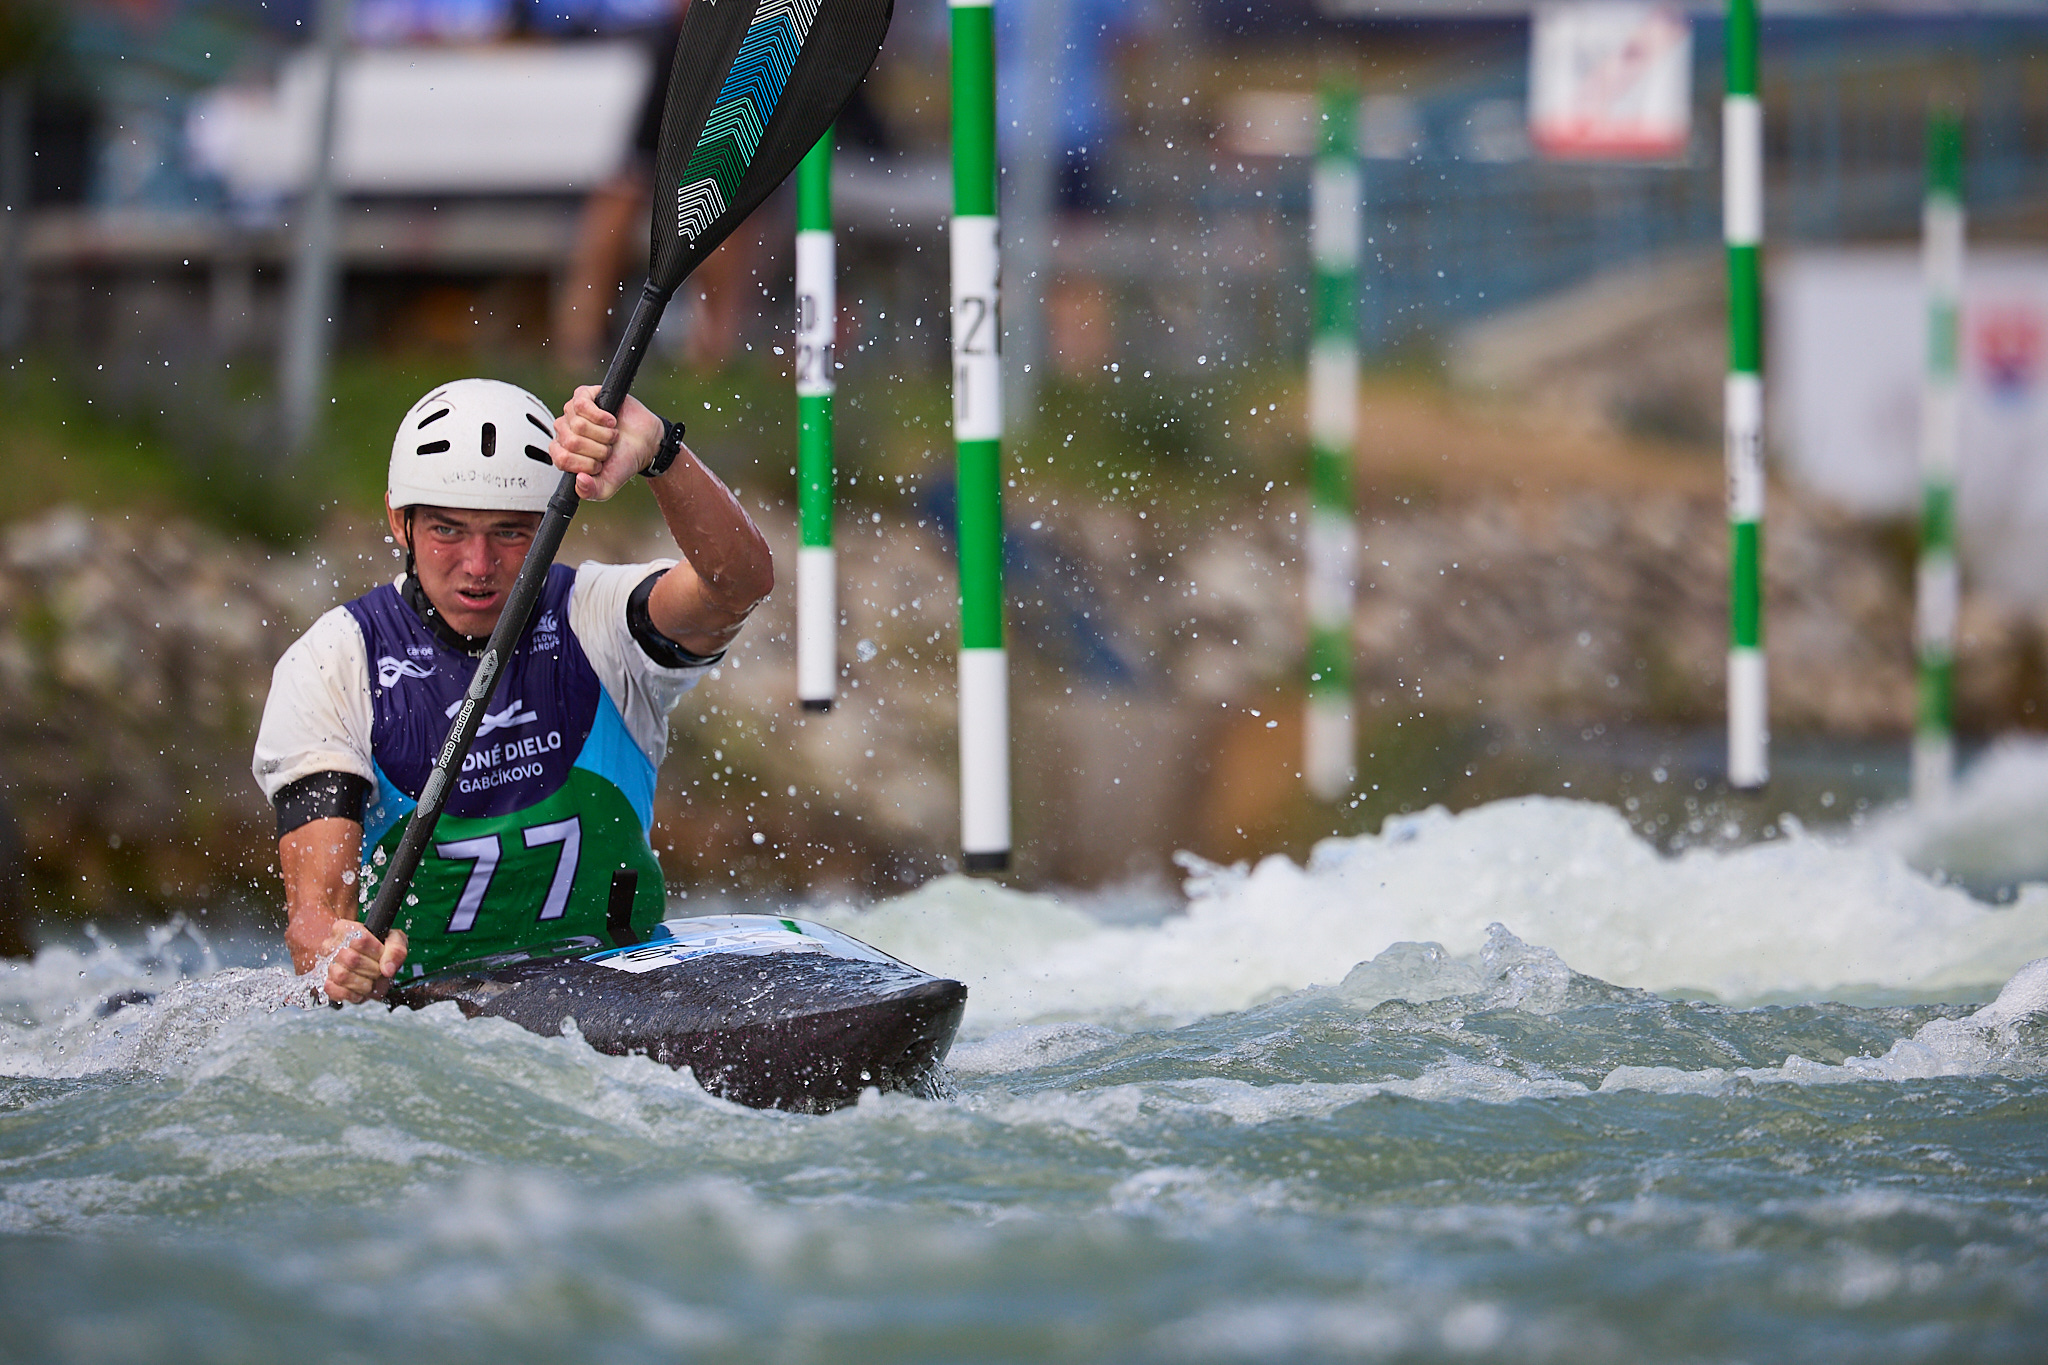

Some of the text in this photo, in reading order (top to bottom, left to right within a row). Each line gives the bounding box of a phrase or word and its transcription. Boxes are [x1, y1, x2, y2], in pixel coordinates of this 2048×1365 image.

[406, 646, 434, 656] canoe
[431, 730, 562, 773] DNÉ DIELO
[438, 698, 476, 769] raab paddles
[459, 761, 544, 794] GABČÍKOVO
[434, 813, 583, 934] 77
